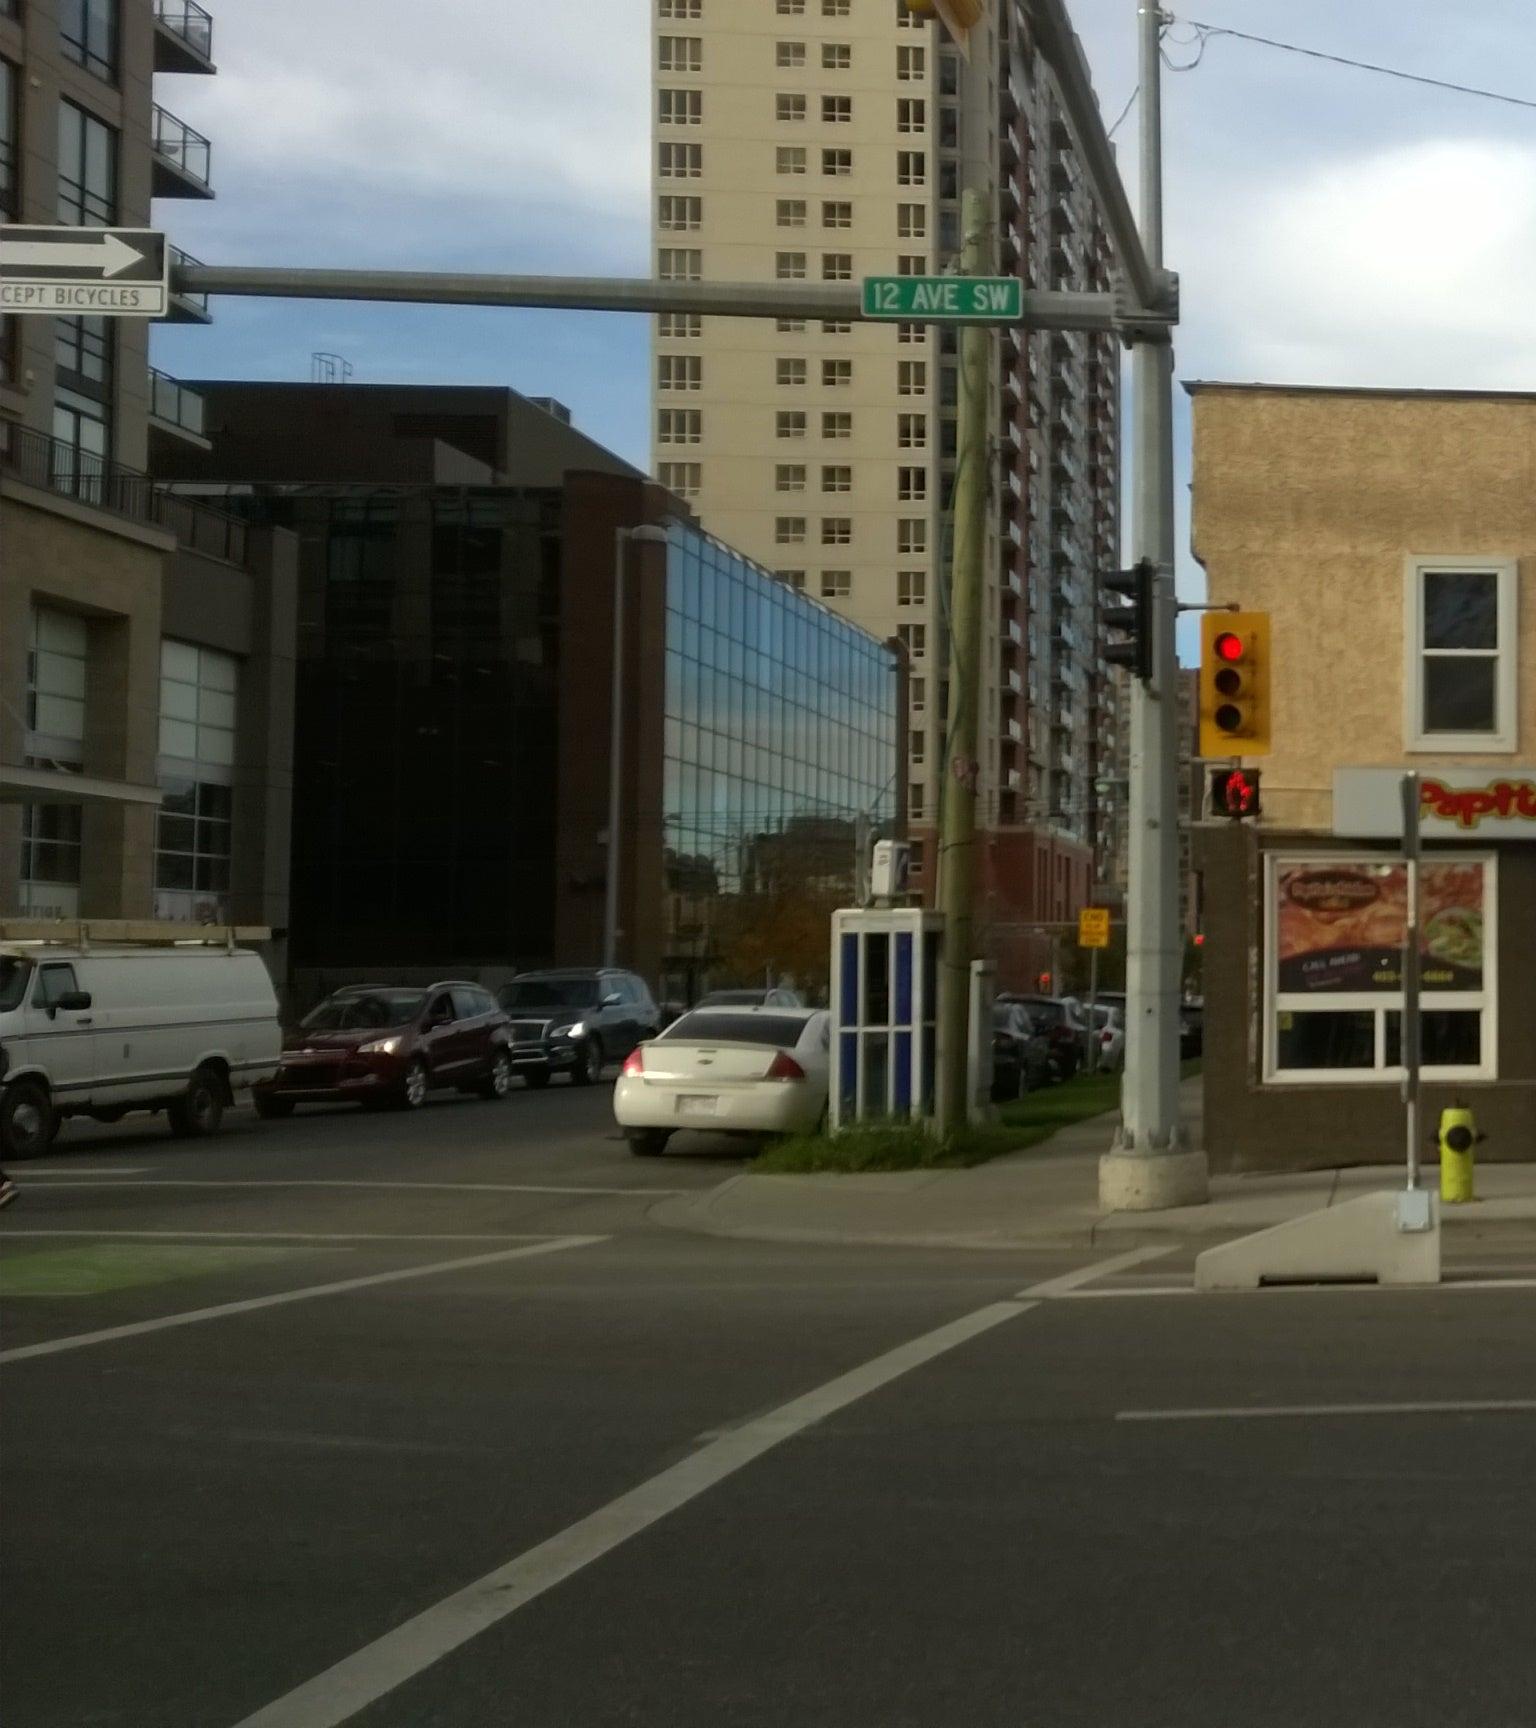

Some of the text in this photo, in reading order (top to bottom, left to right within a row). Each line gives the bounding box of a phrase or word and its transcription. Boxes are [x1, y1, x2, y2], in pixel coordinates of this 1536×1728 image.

[55, 288, 140, 306] BICYCLES
[874, 283, 1009, 311] 12 AVE SW
